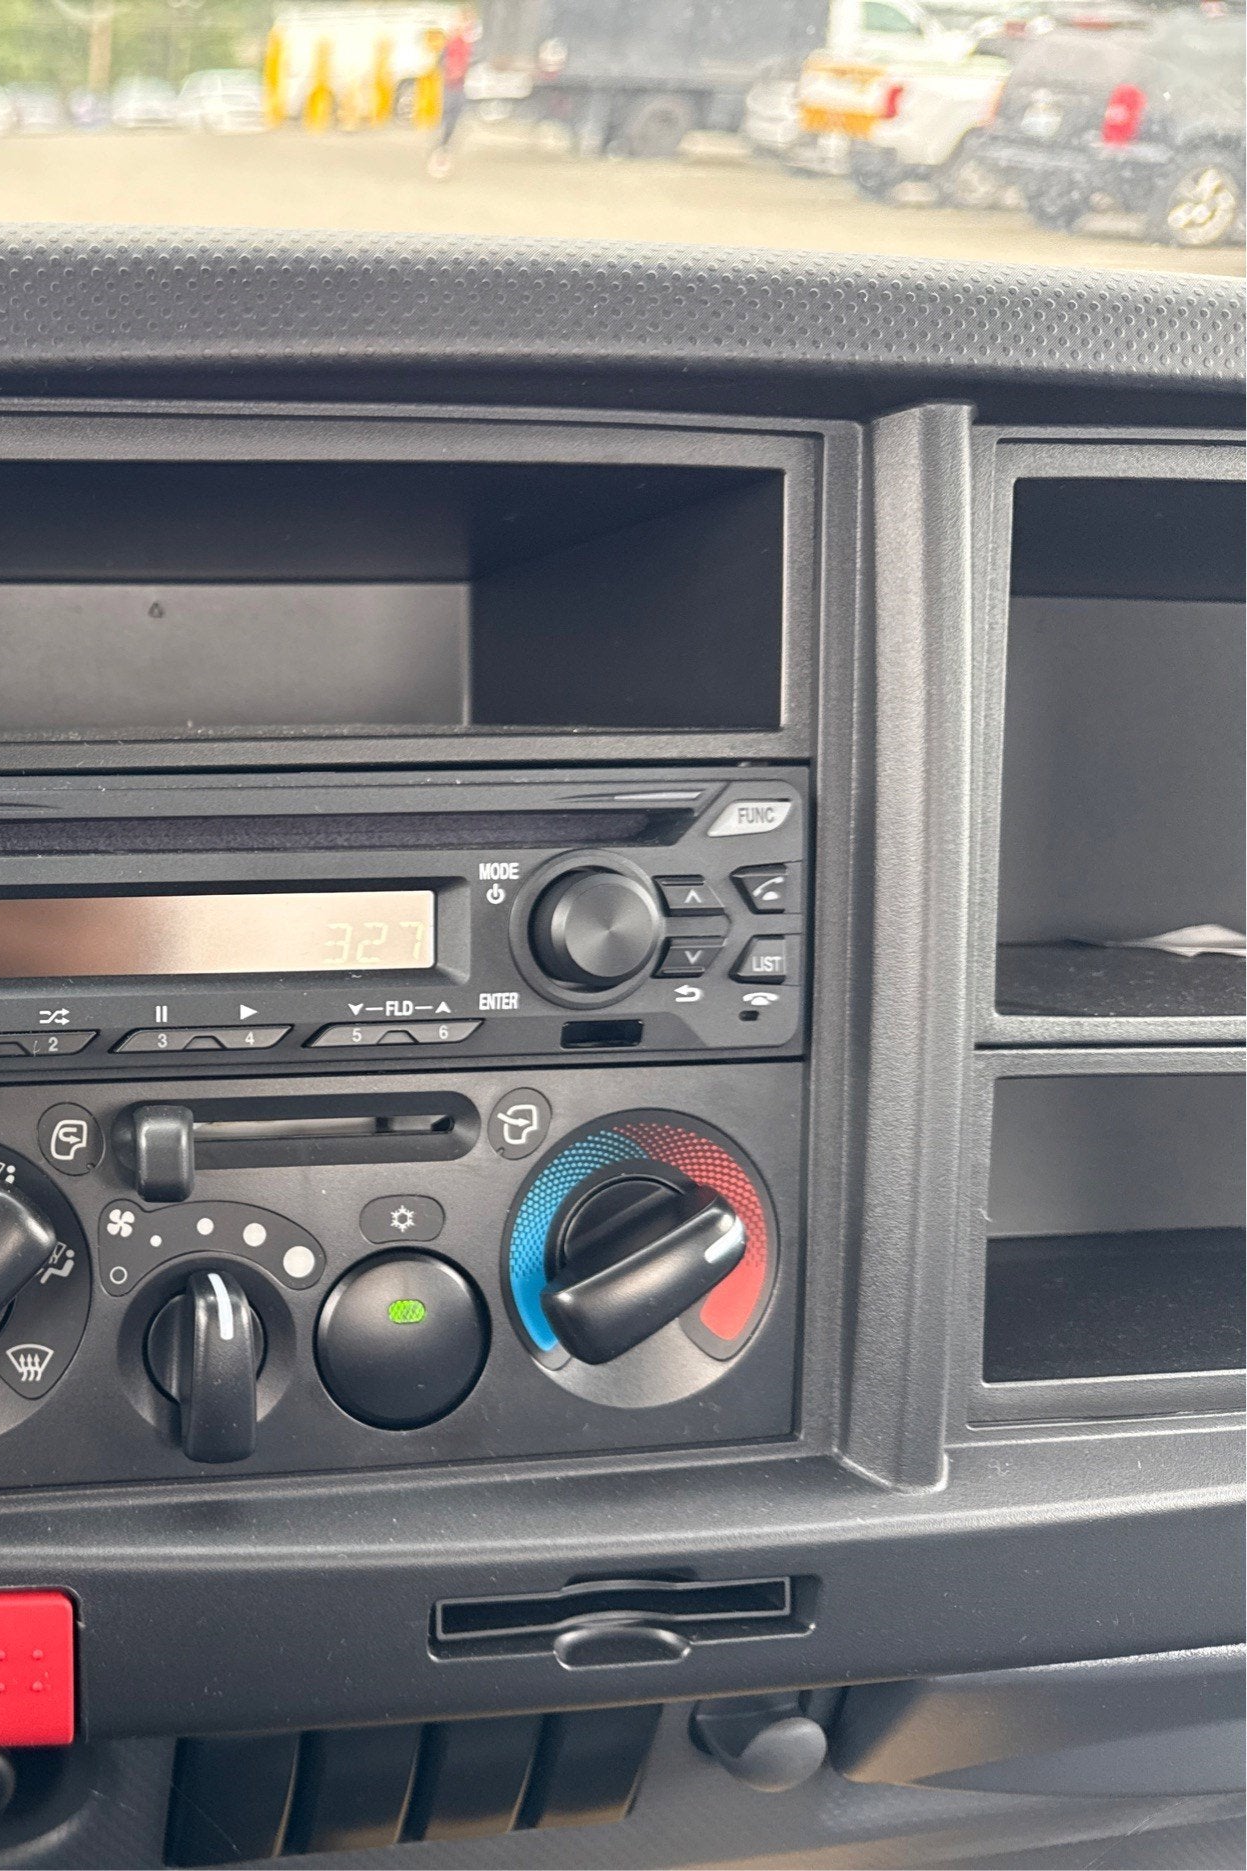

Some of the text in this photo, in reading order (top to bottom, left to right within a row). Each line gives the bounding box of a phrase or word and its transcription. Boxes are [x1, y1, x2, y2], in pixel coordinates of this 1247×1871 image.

[738, 808, 774, 823] FUNC
[478, 862, 520, 880] MODE
[752, 956, 782, 972] LIST
[385, 1000, 414, 1016] FLD
[478, 992, 519, 1010] ENTER
[244, 1031, 255, 1046] 4
[352, 1028, 362, 1042] 5
[438, 1025, 449, 1039] 6
[48, 1036, 59, 1052] 2
[157, 1033, 168, 1048] 3
